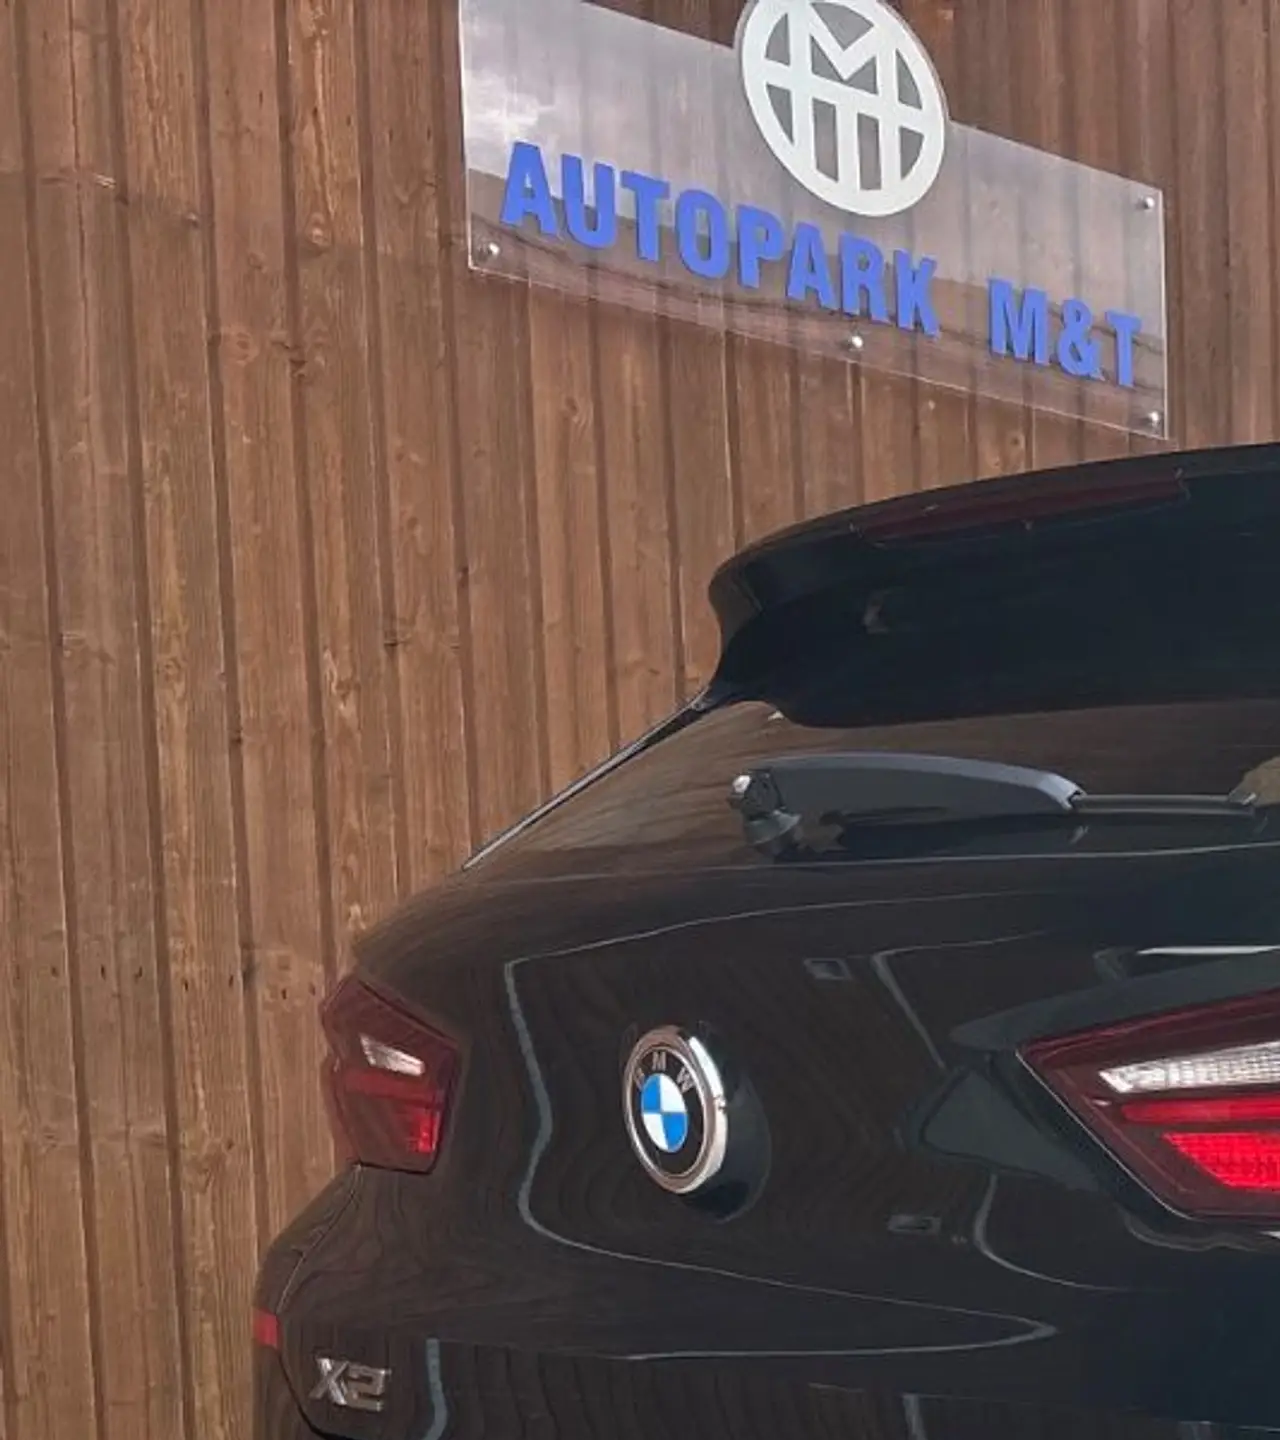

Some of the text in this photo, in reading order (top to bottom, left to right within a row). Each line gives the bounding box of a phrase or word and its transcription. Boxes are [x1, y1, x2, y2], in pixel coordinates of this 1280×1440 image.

[500, 141, 1143, 388] AUTOPARK M&T
[308, 1357, 392, 1412] X2
